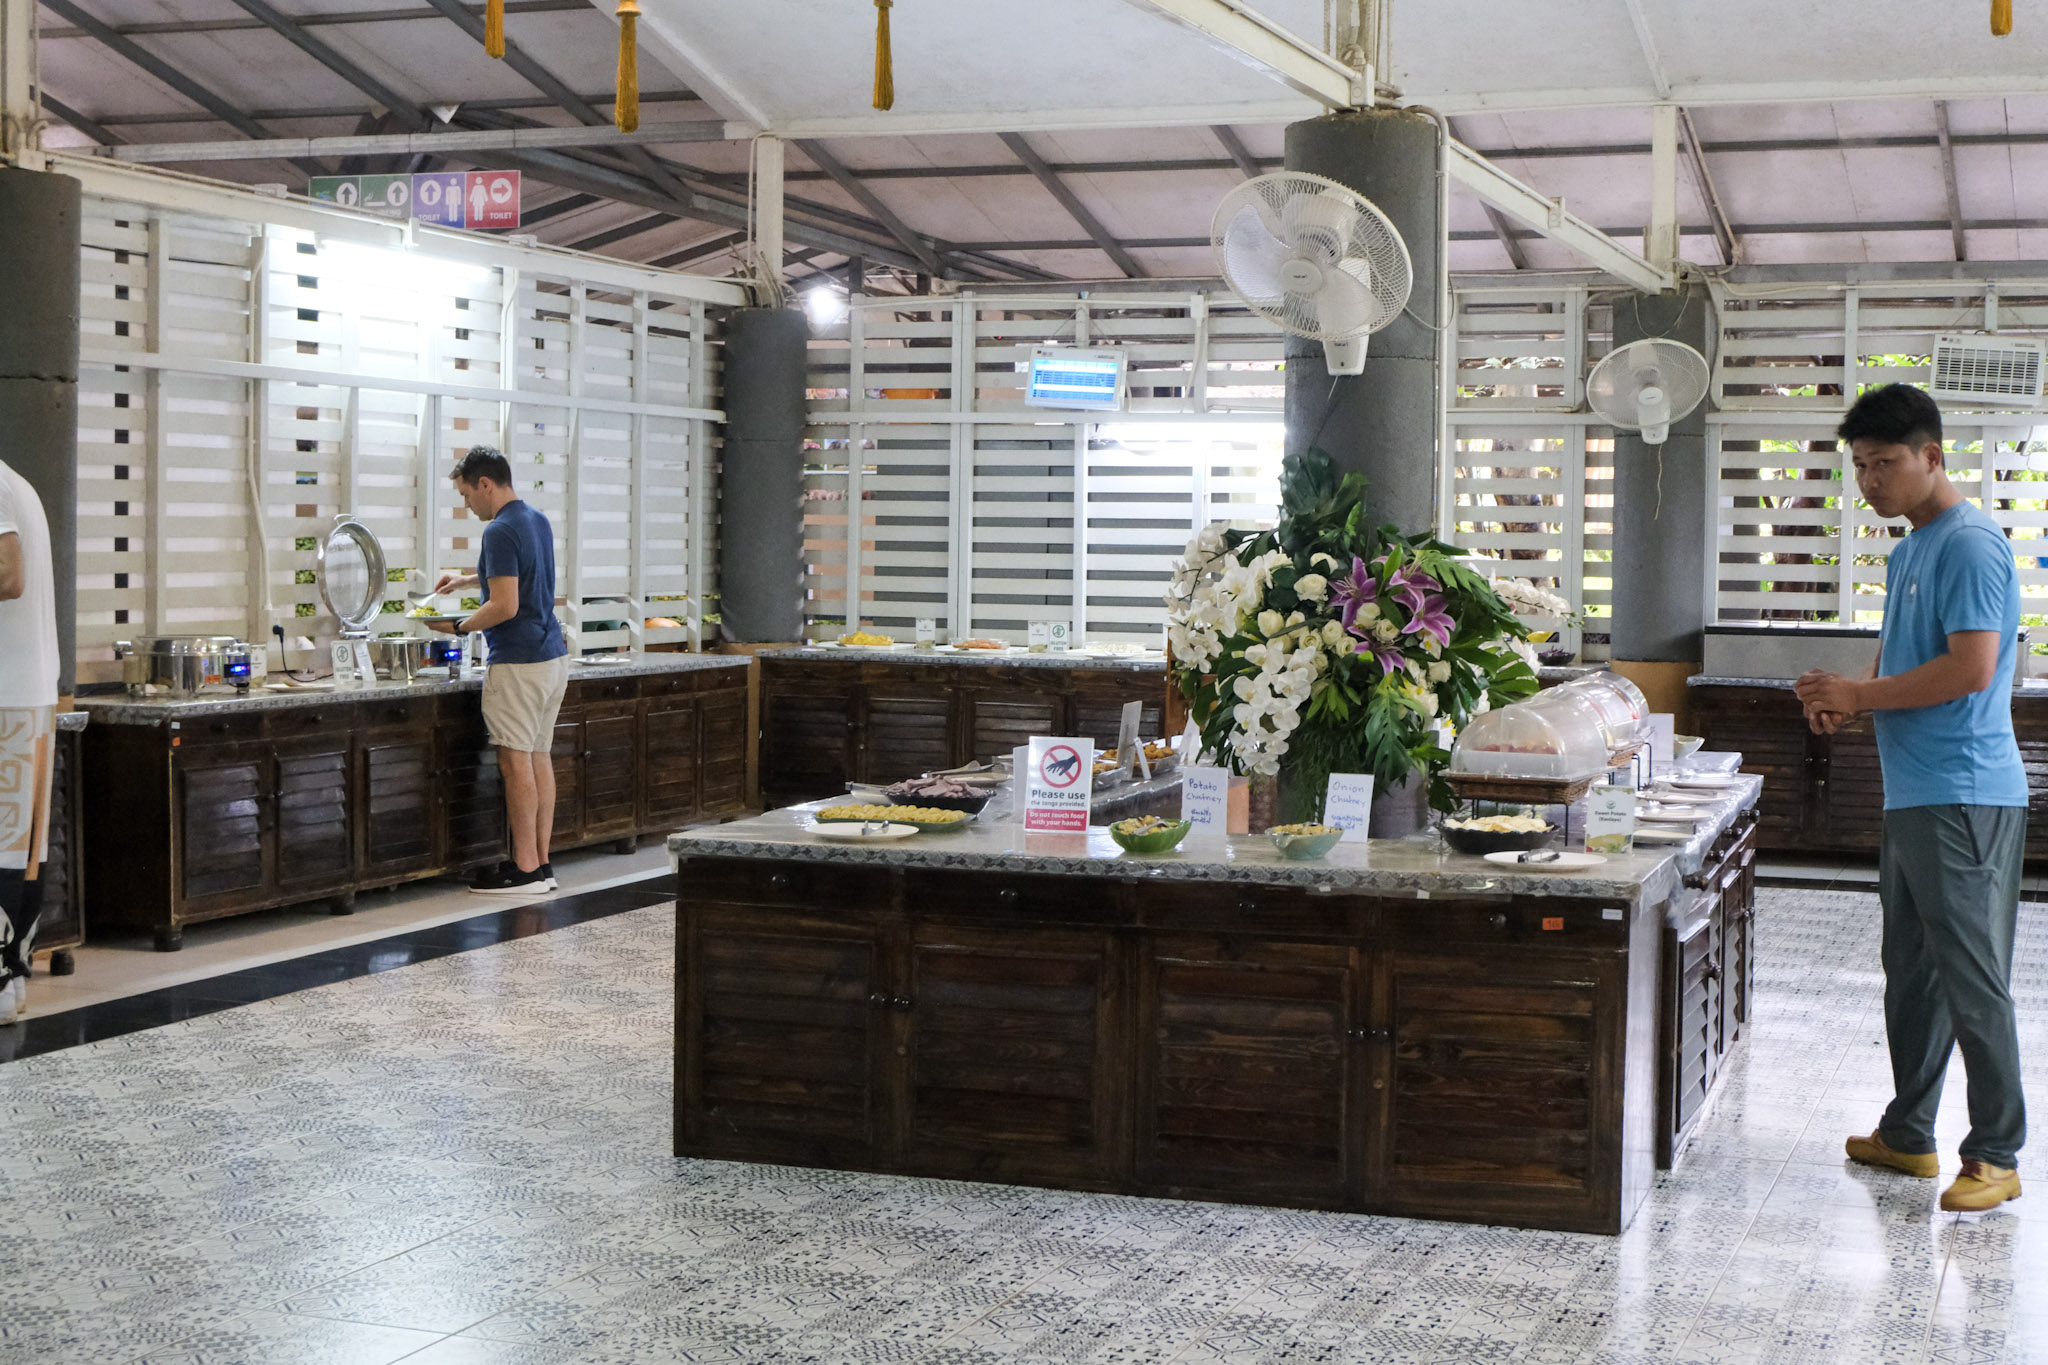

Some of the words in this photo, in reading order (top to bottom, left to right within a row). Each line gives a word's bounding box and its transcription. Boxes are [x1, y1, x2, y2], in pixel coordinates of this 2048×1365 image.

[419, 214, 440, 222] TOILET
[1189, 778, 1217, 791] Potato
[1332, 781, 1364, 792] Onion
[1032, 789, 1064, 799] Please
[1186, 792, 1222, 804] Chutney
[1330, 795, 1366, 808] Chutney
